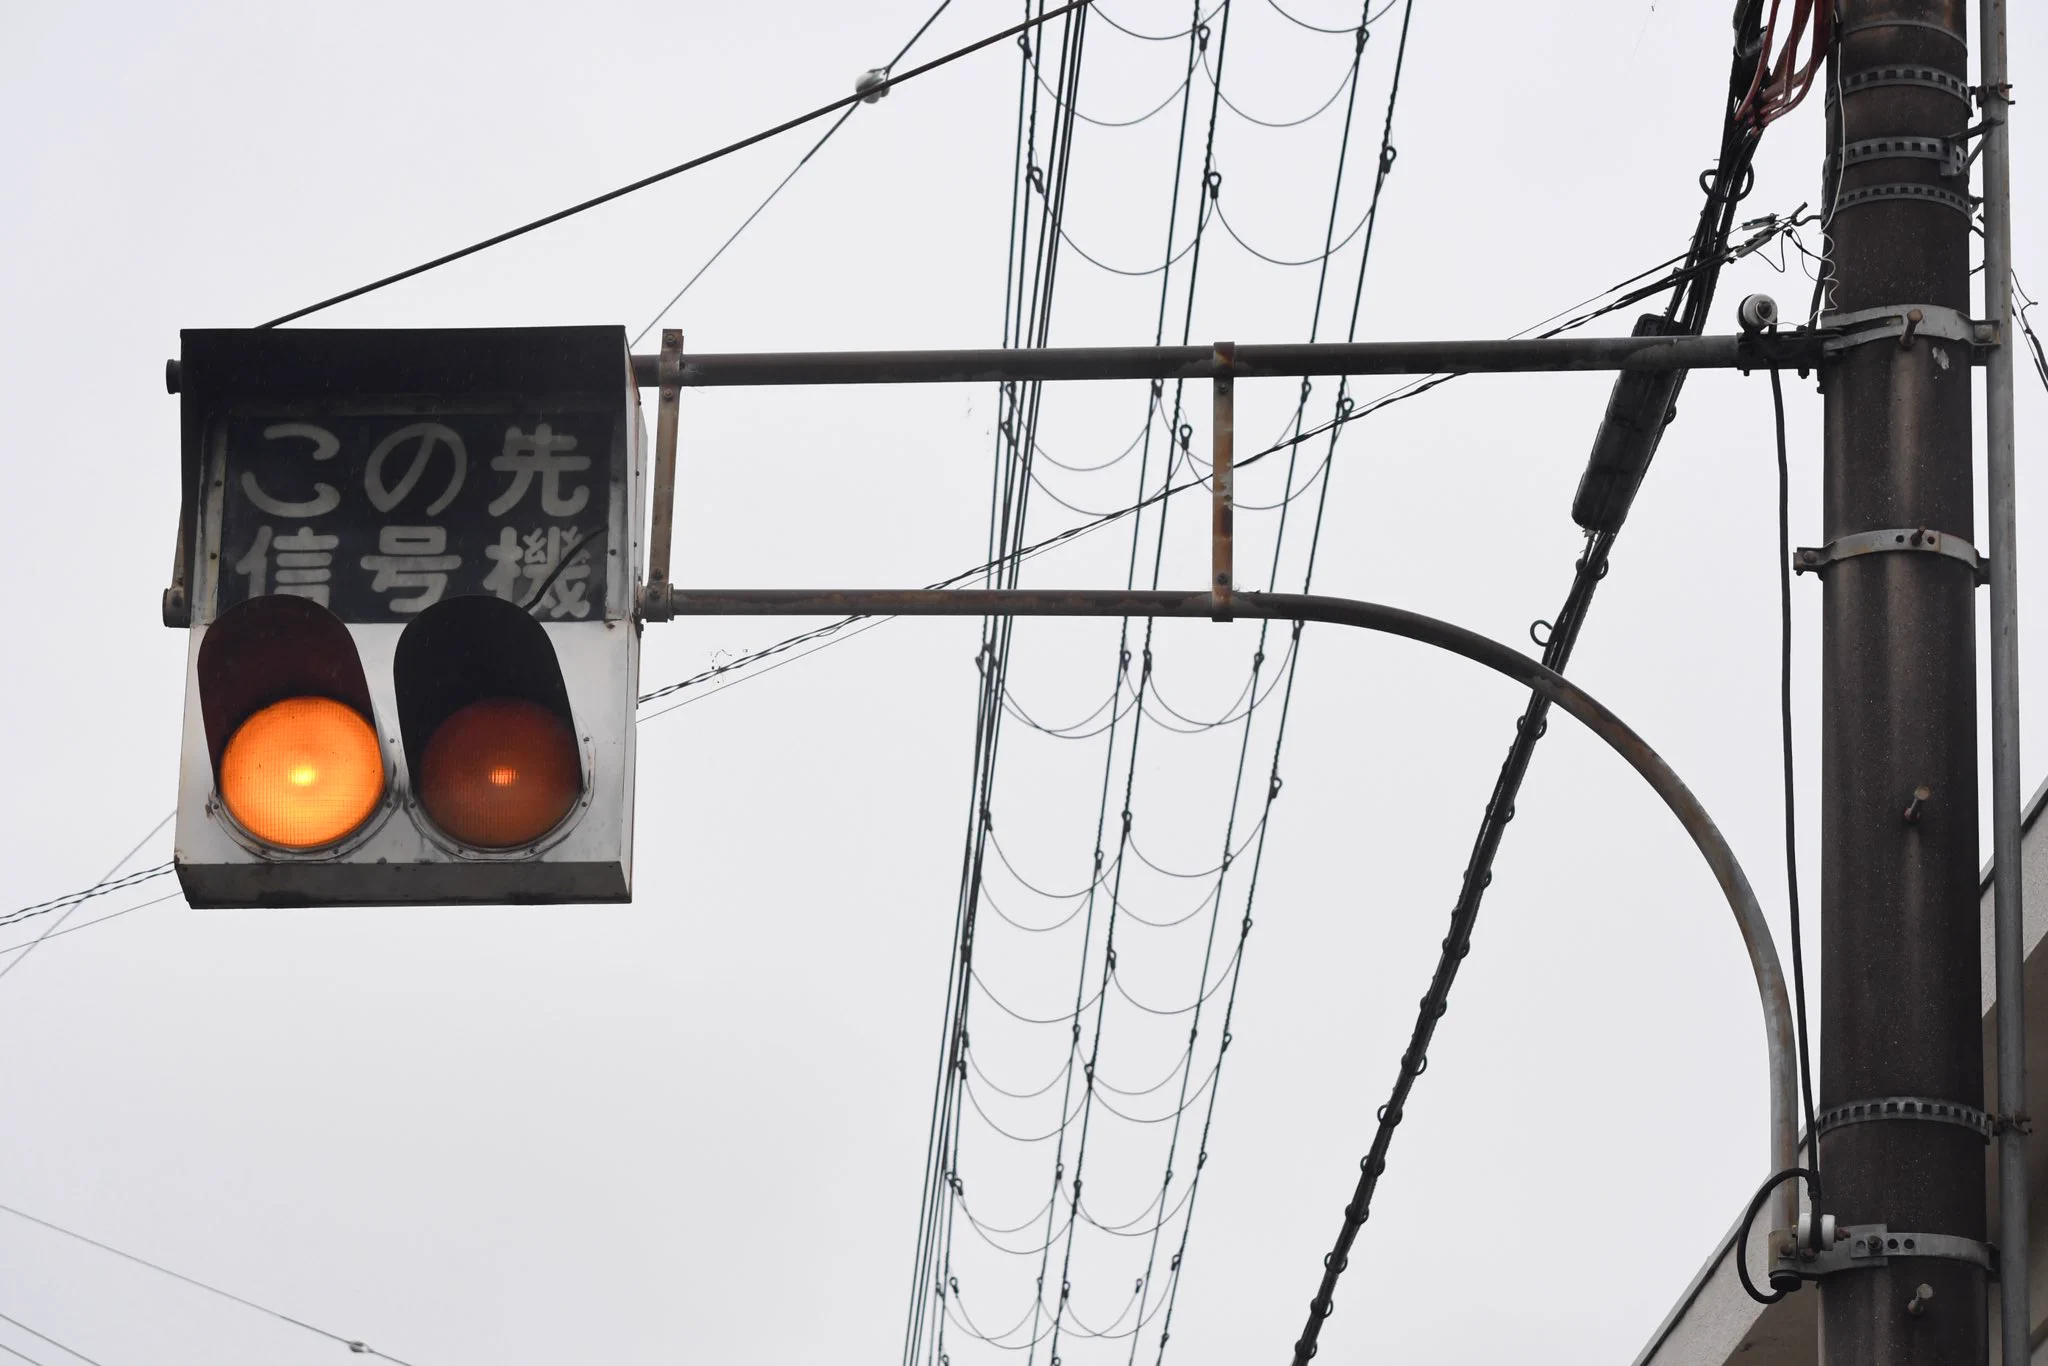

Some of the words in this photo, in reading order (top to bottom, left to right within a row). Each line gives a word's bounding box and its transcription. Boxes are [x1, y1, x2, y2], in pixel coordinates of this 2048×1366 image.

[241, 422, 592, 518] この先
[235, 525, 592, 619] 信号機
